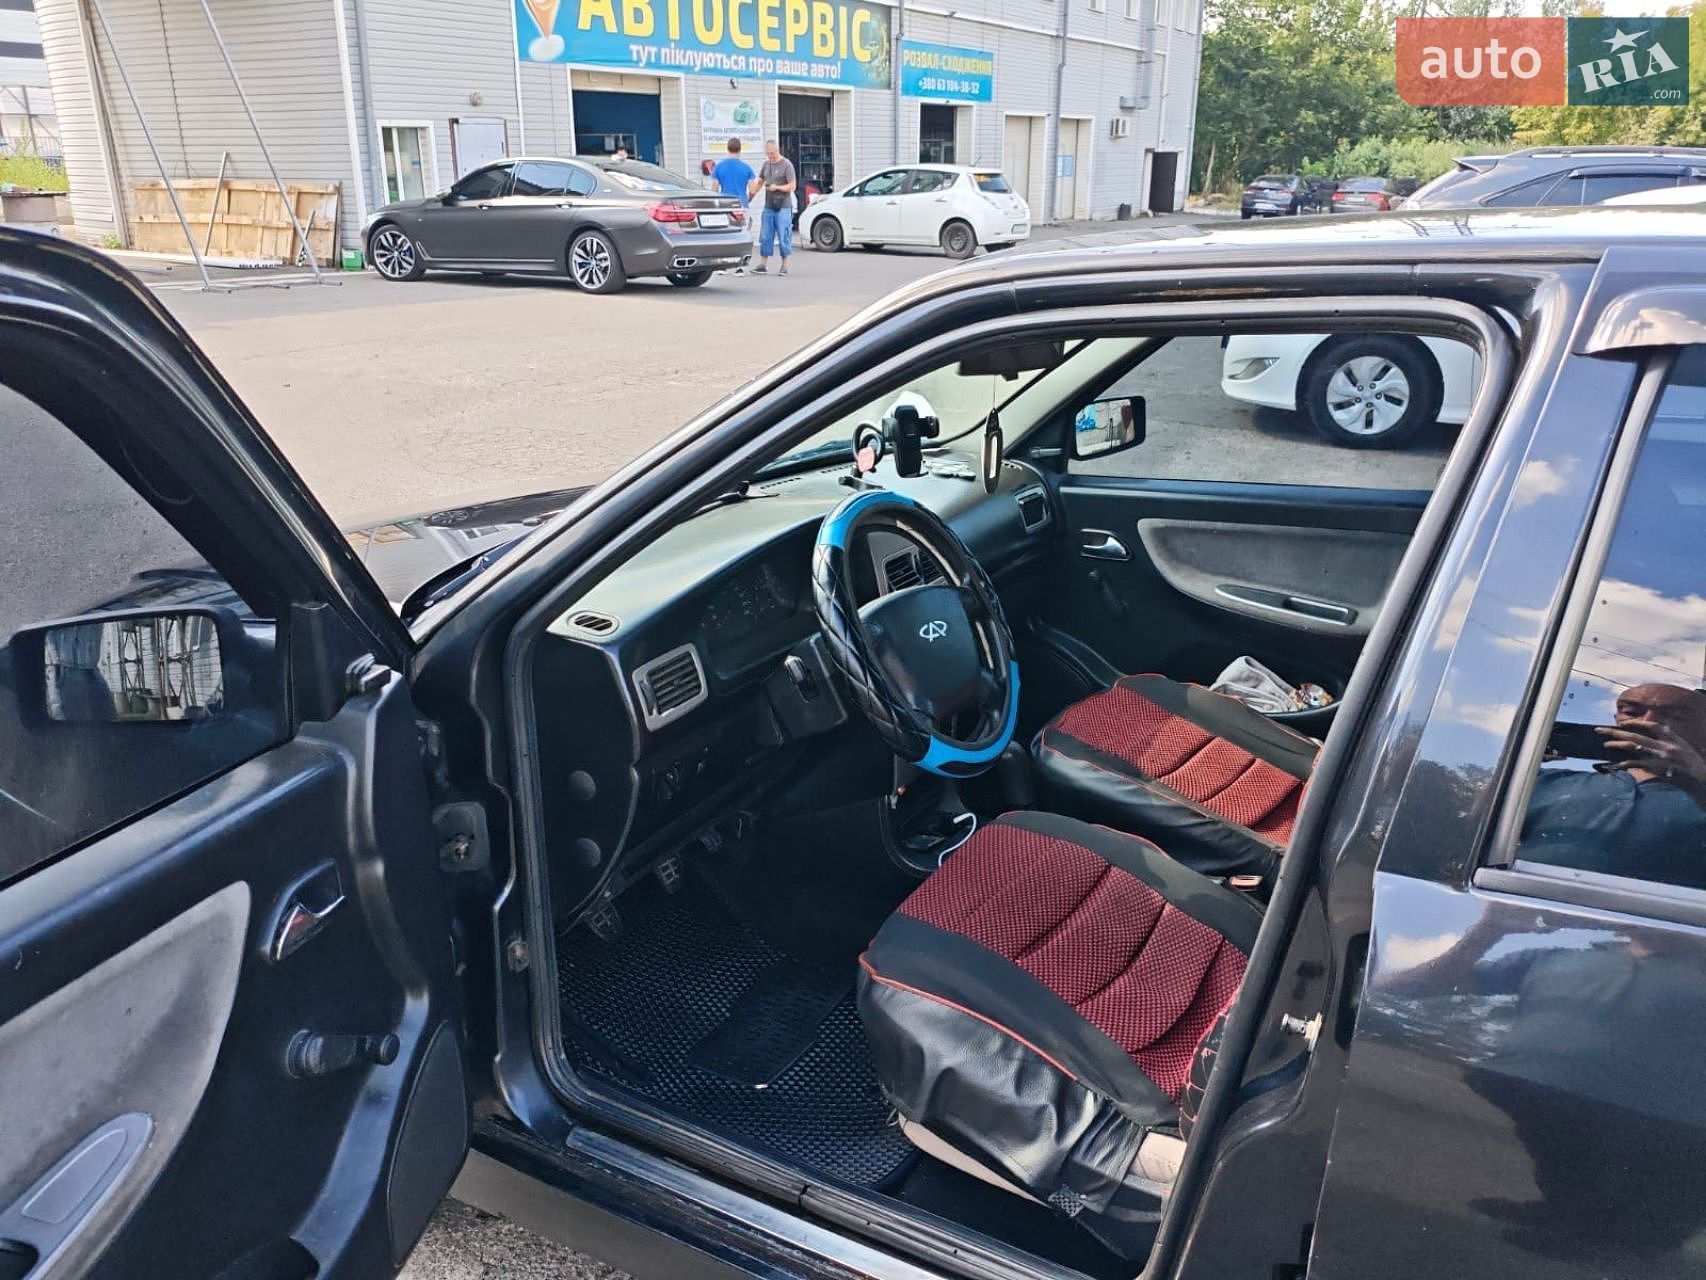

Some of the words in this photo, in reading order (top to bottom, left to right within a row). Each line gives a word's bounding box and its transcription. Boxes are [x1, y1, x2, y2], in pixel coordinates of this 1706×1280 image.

[578, 0, 871, 62] АВТОСЕРВІС
[629, 43, 658, 66] тут
[660, 42, 744, 71] піклуються
[748, 56, 774, 75] про
[775, 59, 808, 77] ваше
[810, 61, 841, 79] авто!
